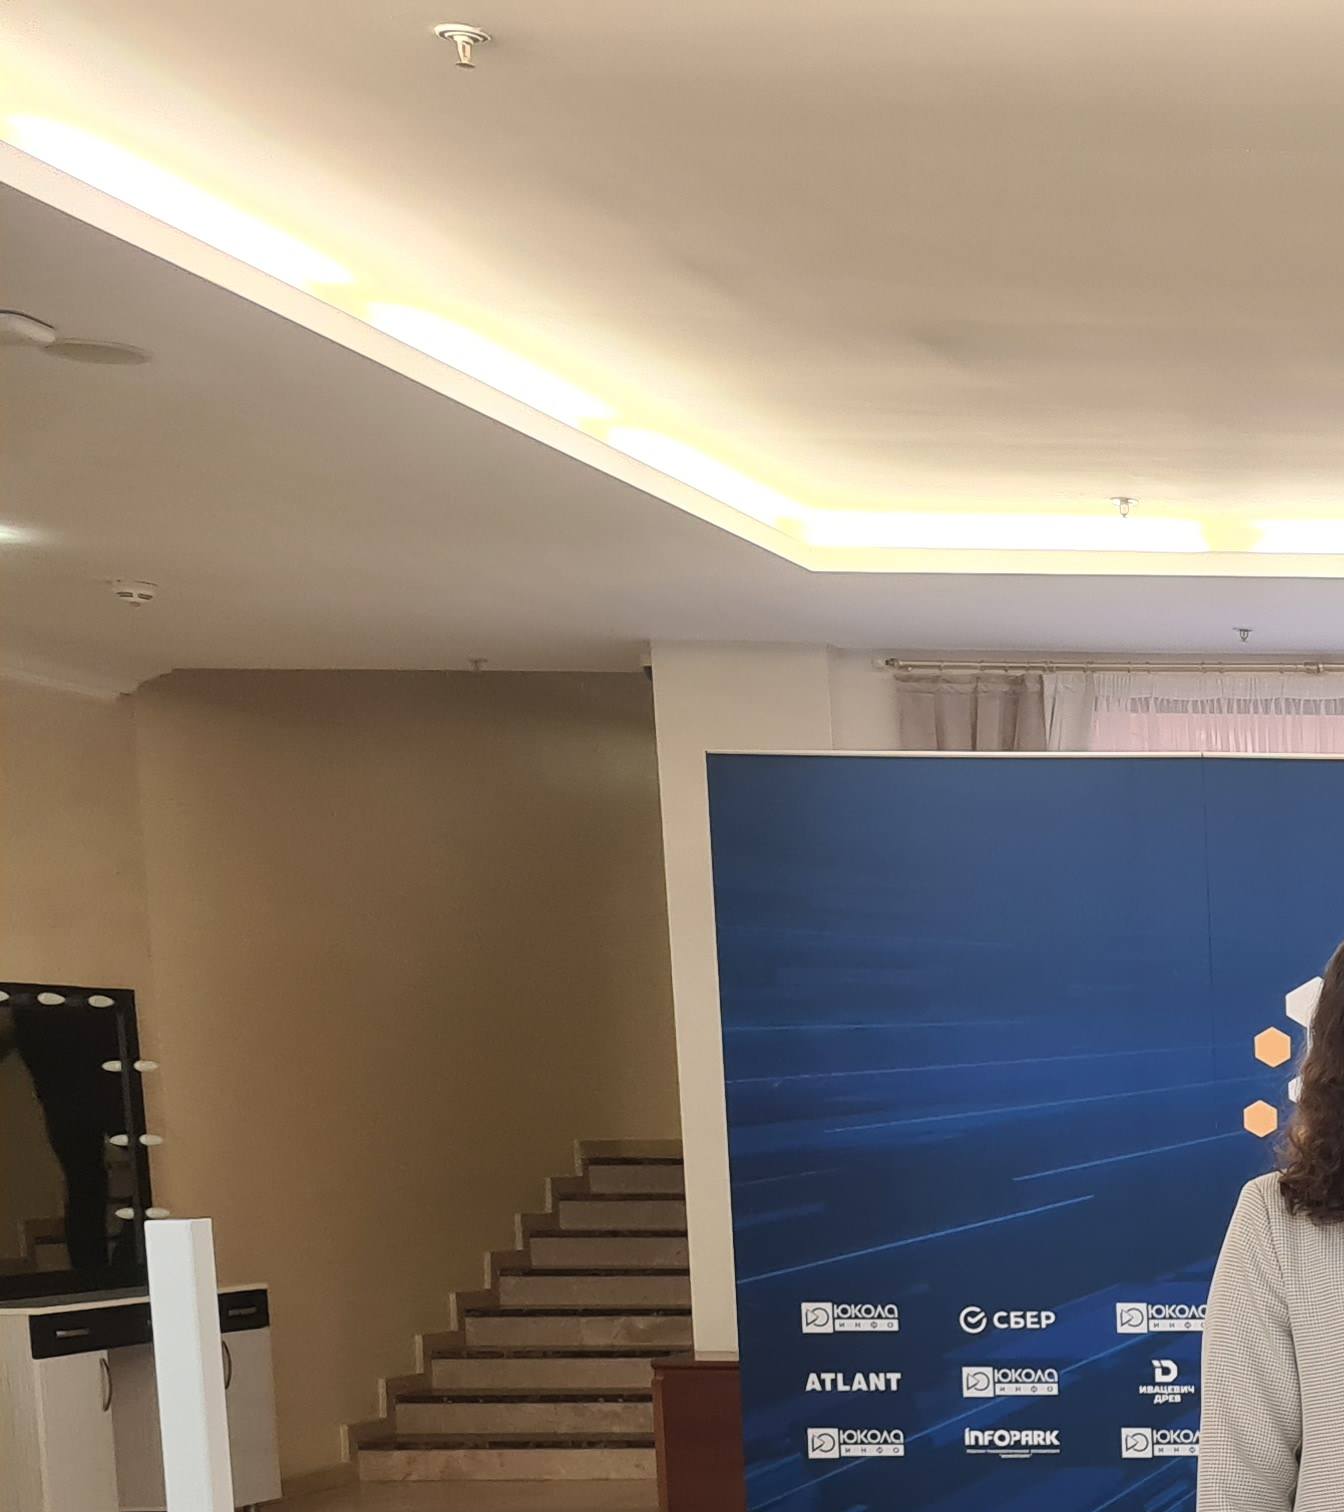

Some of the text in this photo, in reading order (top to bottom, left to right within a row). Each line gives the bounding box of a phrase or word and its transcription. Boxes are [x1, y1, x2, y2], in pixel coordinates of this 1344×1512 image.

[993, 1311, 1056, 1329] СБЕР
[805, 1372, 902, 1391] ATLANT
[1153, 1394, 1182, 1404] ДРЕВ
[1153, 1429, 1200, 1444] ЮКОЛ
